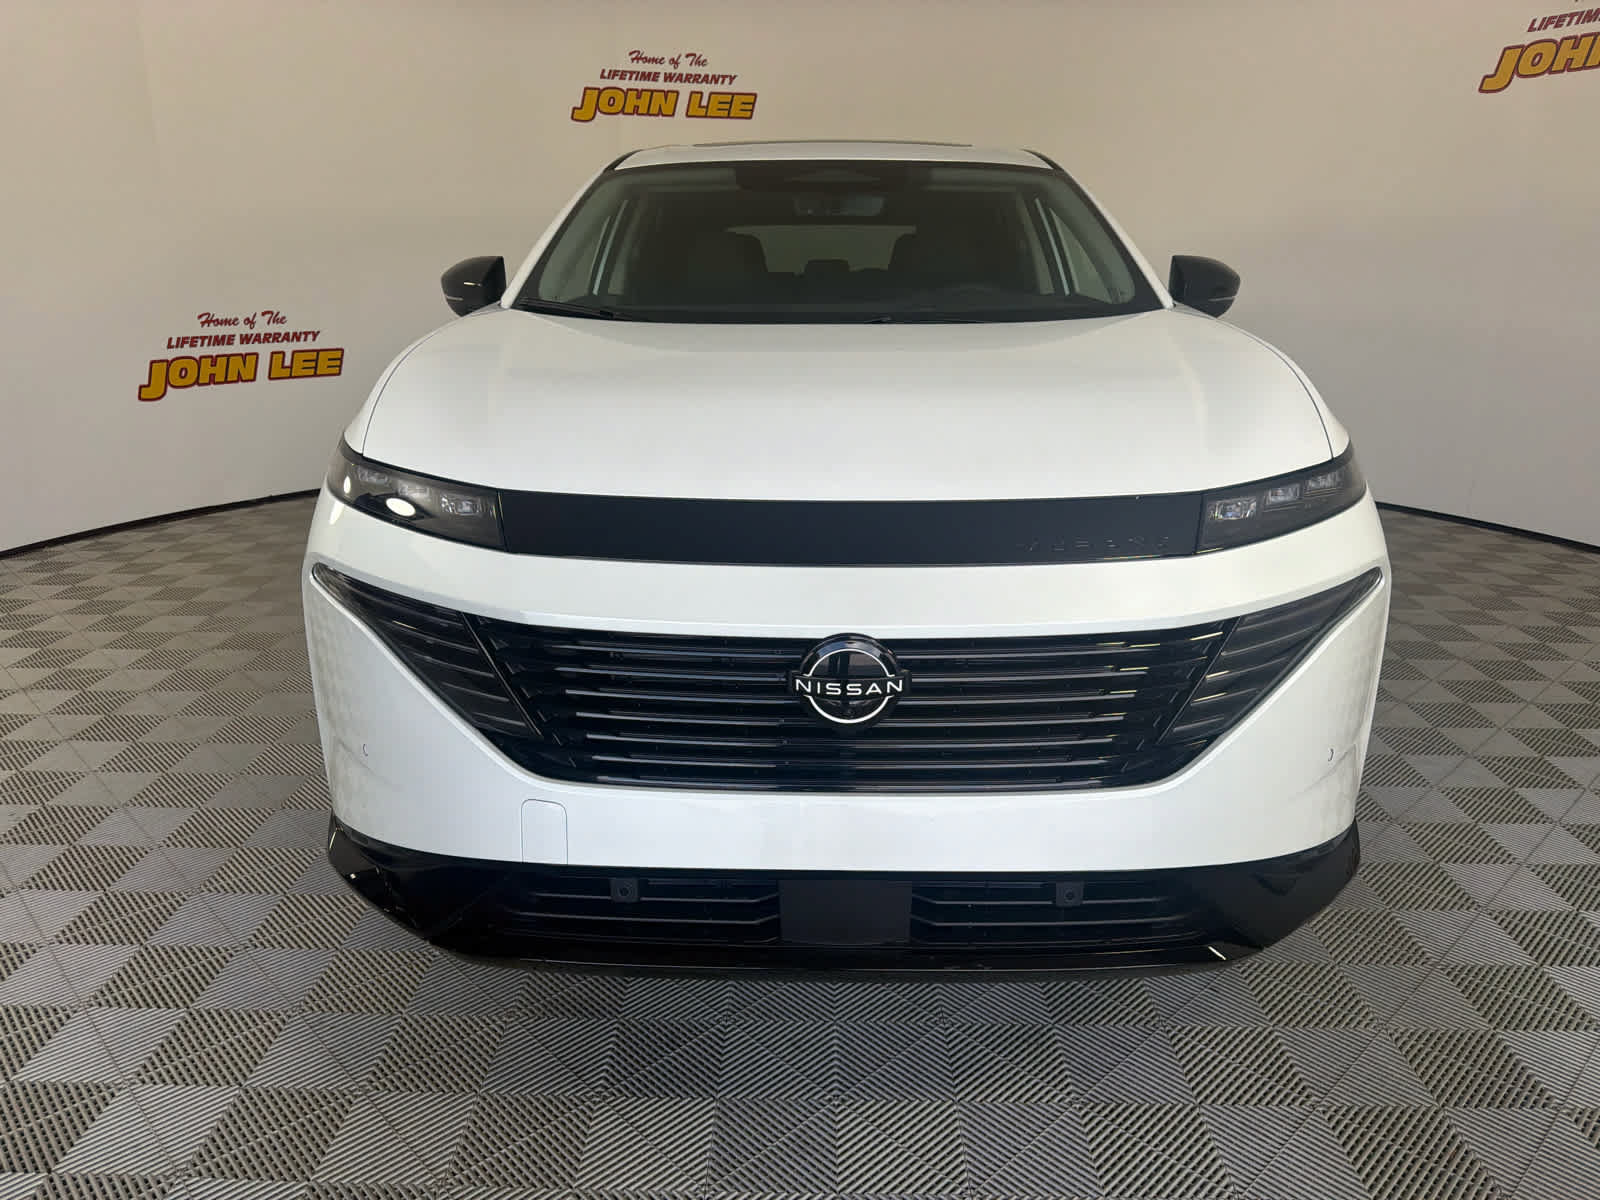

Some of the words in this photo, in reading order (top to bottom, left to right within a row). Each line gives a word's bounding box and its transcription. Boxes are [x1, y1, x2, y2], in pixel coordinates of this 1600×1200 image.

[1526, 7, 1600, 32] LIFETIM
[628, 50, 665, 65] Home
[669, 53, 681, 69] of
[685, 53, 709, 67] The
[600, 69, 660, 82] LIFETIME
[663, 72, 738, 86] WARRANTY
[571, 86, 679, 122] JOHN
[686, 91, 757, 120] LEE
[197, 312, 240, 328] Home
[243, 312, 257, 329] of
[261, 310, 288, 326] The
[167, 334, 236, 349] LIFETIME
[239, 330, 321, 345] WARRANTY
[138, 352, 259, 401] JOHN
[268, 348, 344, 380] LEE
[795, 679, 903, 696] NISSAN
